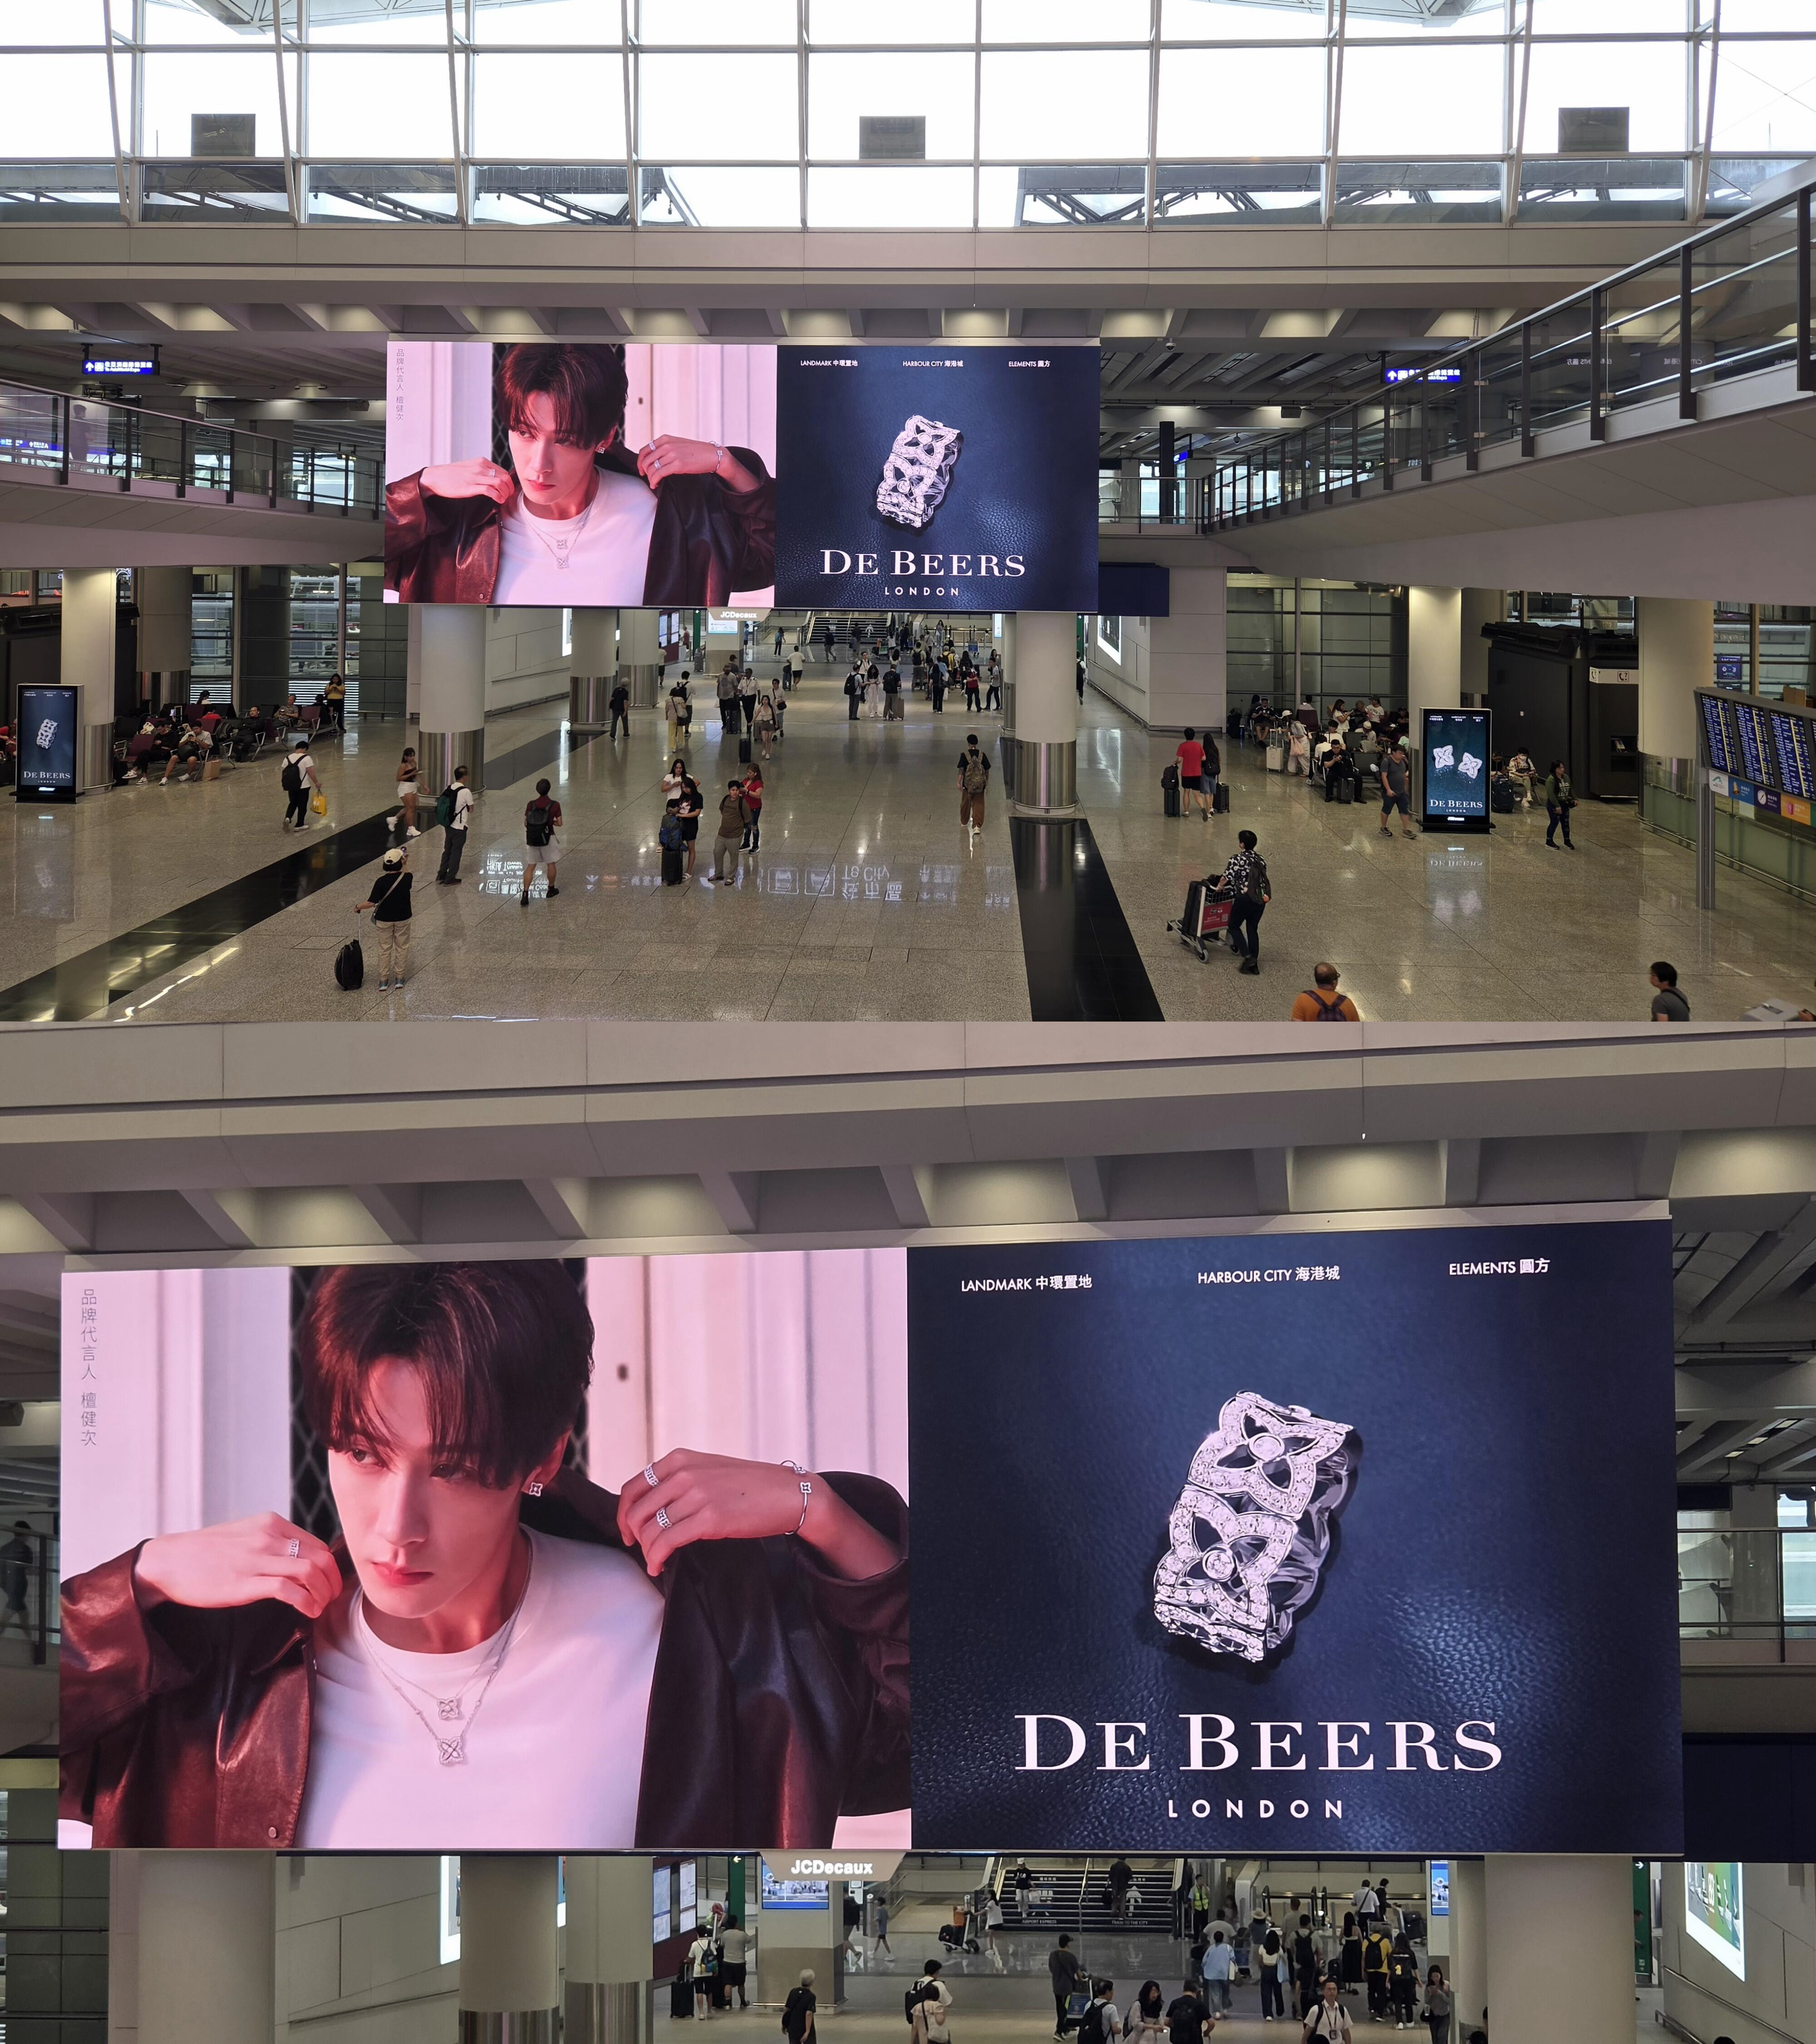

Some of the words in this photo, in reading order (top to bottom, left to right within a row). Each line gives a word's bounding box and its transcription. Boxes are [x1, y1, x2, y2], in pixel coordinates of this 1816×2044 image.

[396, 349, 404, 391] 品牌代言人
[396, 396, 404, 421] 檀健次
[819, 550, 879, 575] DE
[890, 550, 1025, 577] BEERS
[885, 586, 959, 596] LONDON
[1448, 800, 1483, 808] BEERS
[1198, 1270, 1261, 1284] HARBOUR
[1264, 1269, 1292, 1282] CITY
[1295, 1265, 1340, 1282] 海港城
[1450, 1261, 1516, 1275] ELEMENTS
[1519, 1258, 1551, 1274] 圓方
[961, 1278, 1032, 1291] LANDMARK
[1036, 1274, 1092, 1290] 中環置地
[81, 1289, 97, 1380] 品牌代言人
[81, 1392, 97, 1446] 檀健次
[1014, 1714, 1150, 1771] DE
[1178, 1714, 1502, 1771] BEERS
[1168, 1799, 1342, 1819] LONDON
[790, 1860, 873, 1874] JCDecaux
